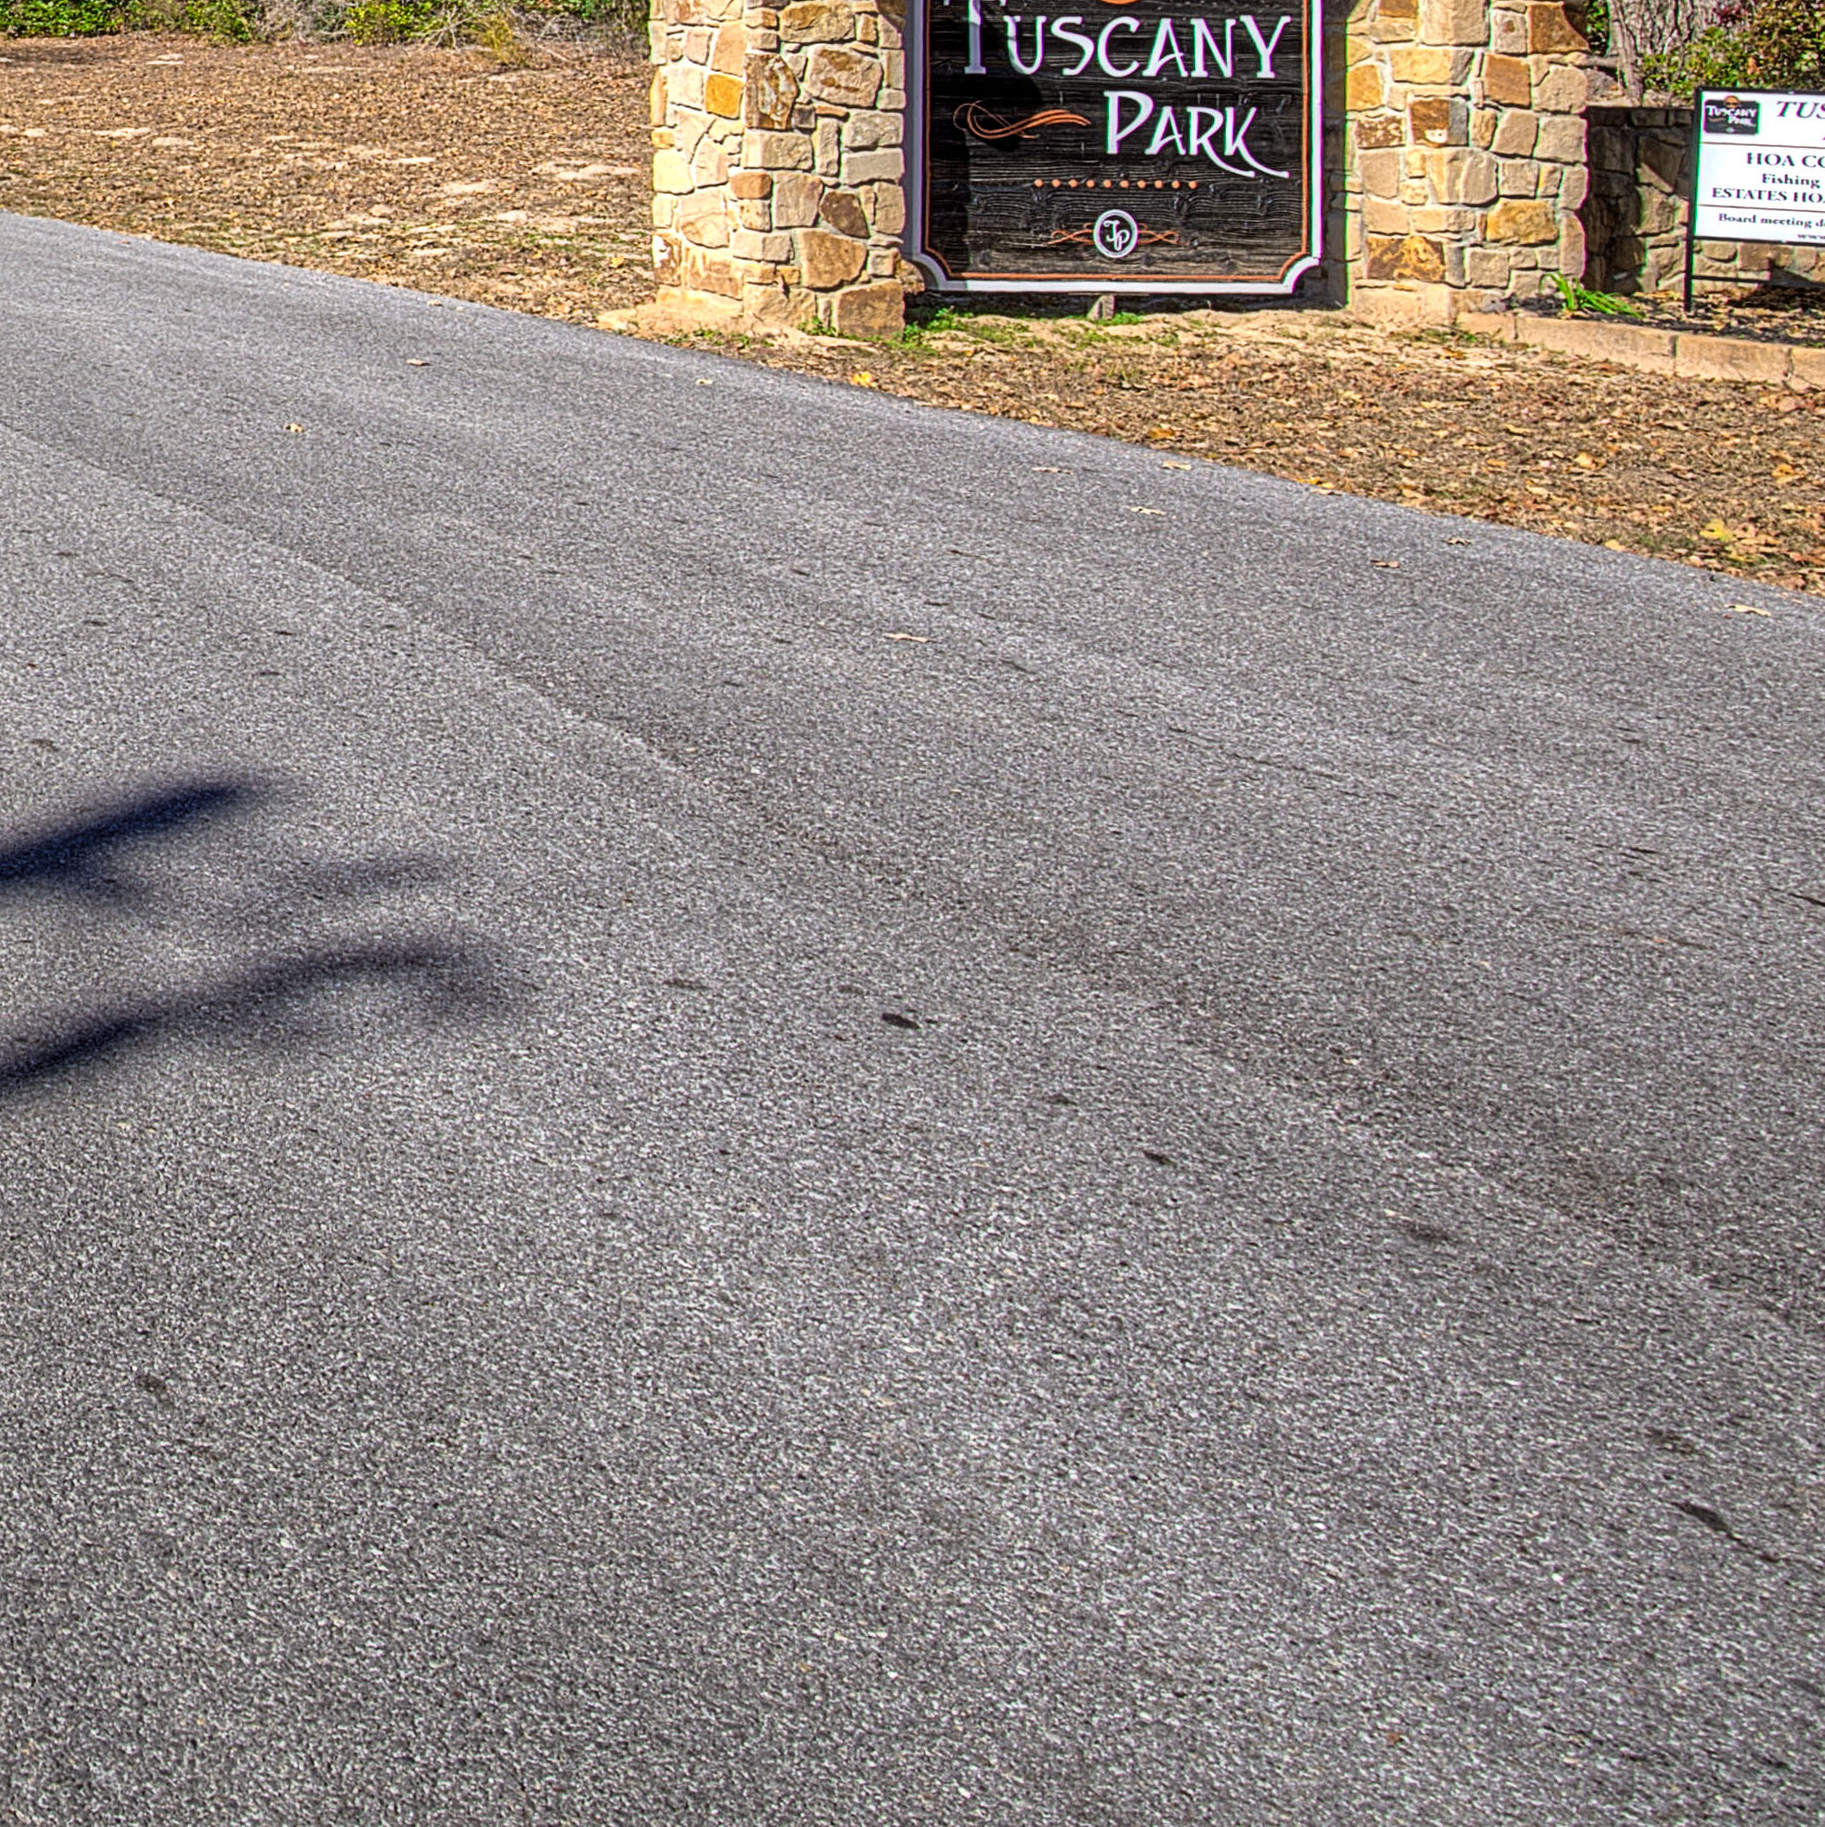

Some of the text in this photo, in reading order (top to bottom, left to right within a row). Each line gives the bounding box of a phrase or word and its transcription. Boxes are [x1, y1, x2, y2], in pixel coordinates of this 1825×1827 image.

[1706, 105, 1757, 117] TUSCANY
[1103, 90, 1290, 179] PARK
[1746, 152, 1795, 167] HOA
[1761, 172, 1821, 189] Fishing
[1711, 187, 1825, 204] ESTATES HO
[1718, 212, 1757, 224] Board
[1760, 216, 1813, 229] meeting
